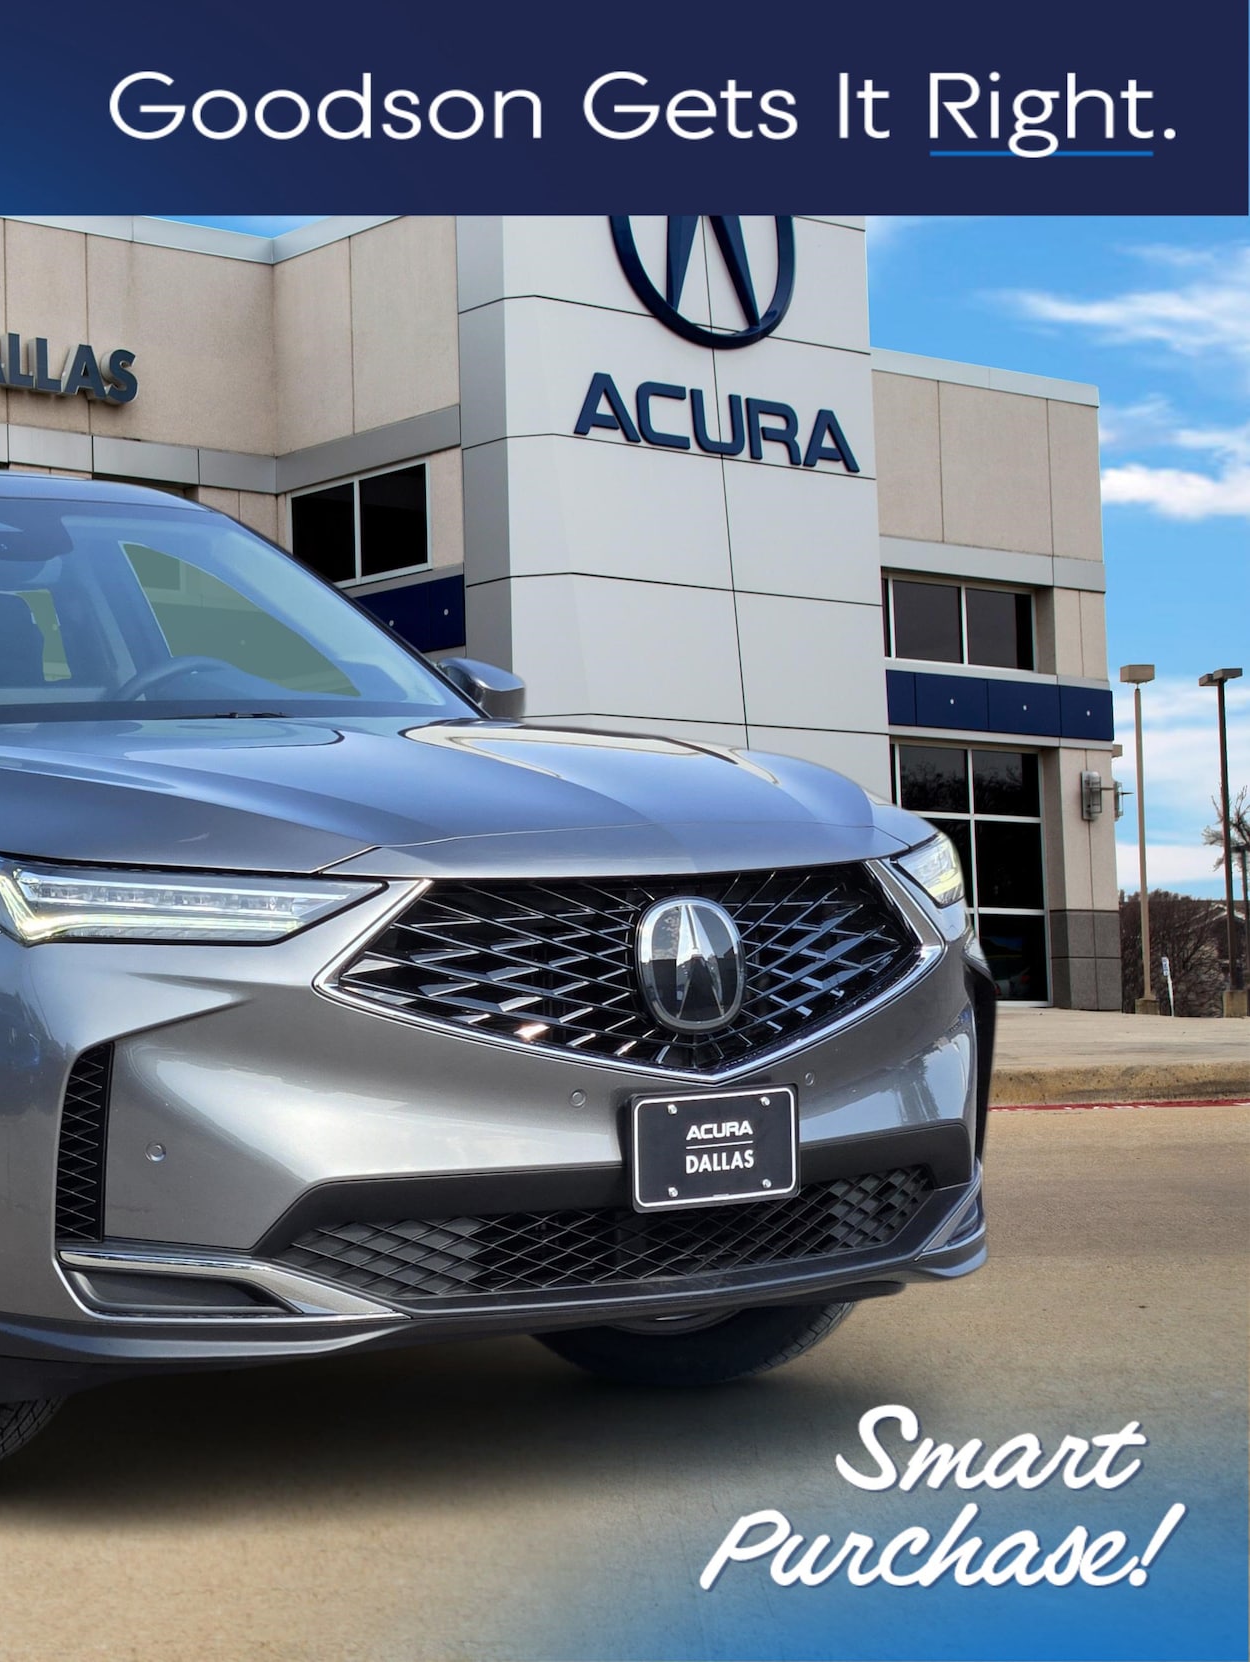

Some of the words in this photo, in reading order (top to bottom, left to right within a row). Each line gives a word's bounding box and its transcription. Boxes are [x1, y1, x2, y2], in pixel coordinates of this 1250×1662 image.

[573, 372, 860, 473] ACURA
[685, 1120, 754, 1141] ACURA
[685, 1149, 755, 1174] DALLAS
